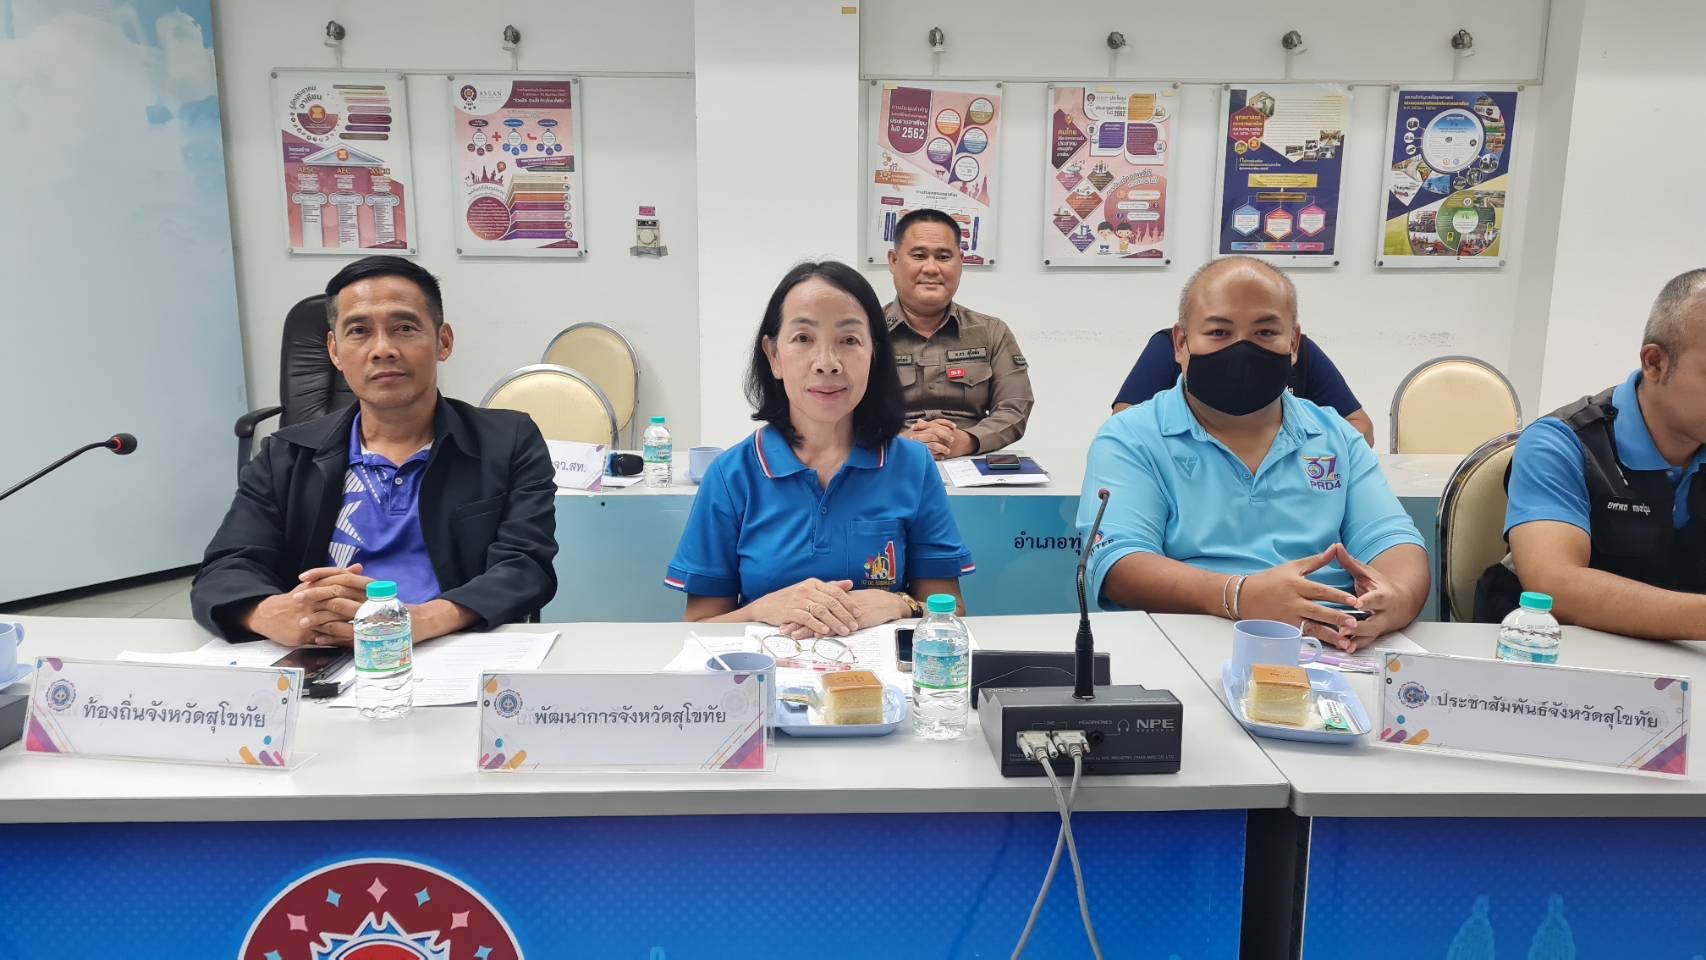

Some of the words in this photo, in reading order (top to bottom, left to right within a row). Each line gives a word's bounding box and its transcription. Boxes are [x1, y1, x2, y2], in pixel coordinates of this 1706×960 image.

[901, 127, 925, 140] 2562
[1310, 480, 1341, 491] PRD4
[1014, 530, 1082, 556] อำเภอทุ่
[82, 693, 266, 734] ท้องถิ่นจังหวัดสุโขทัย
[534, 702, 726, 731] พัฒนาการจังหวัดสุโขทัย
[1136, 718, 1175, 729] NPE
[1437, 692, 1659, 731] ประชาสัมพันธ์จังหวัดสุโขทัย
